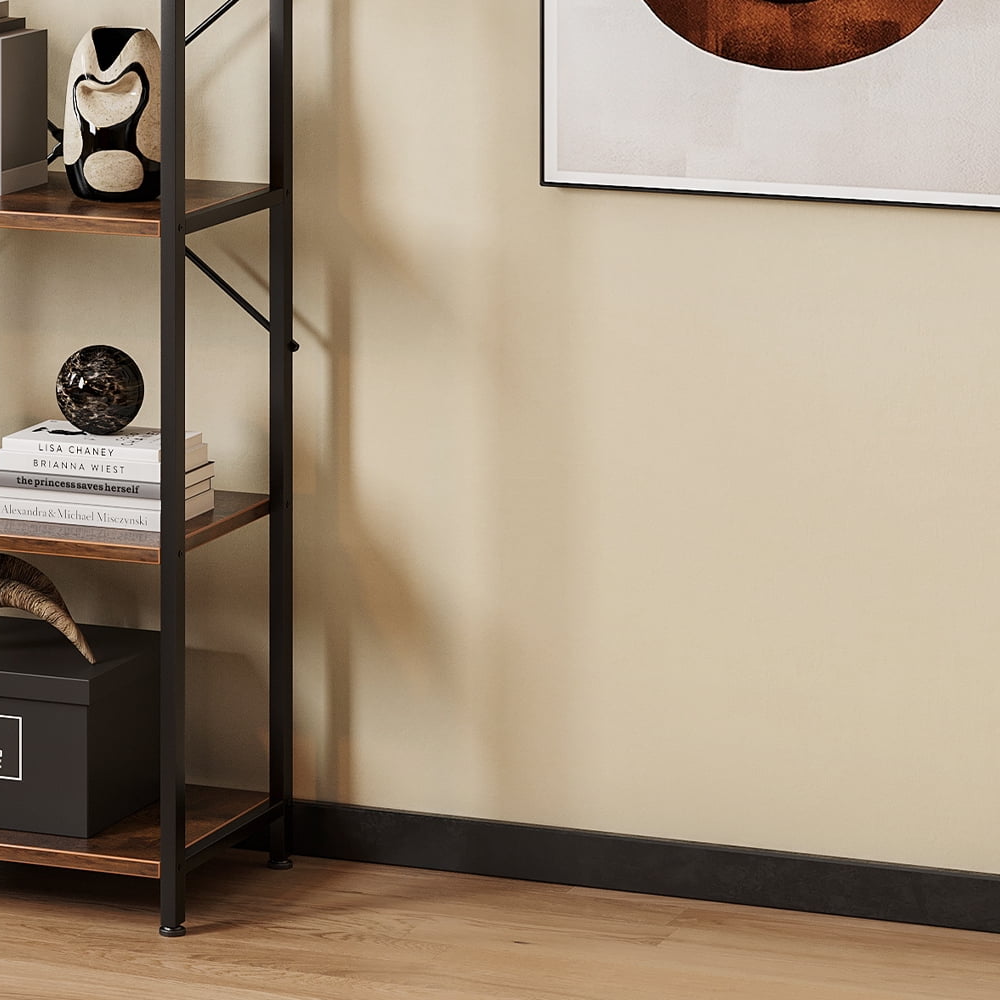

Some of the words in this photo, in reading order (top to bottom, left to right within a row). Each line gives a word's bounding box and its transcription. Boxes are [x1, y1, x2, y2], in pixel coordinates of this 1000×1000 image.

[38, 443, 63, 453] LISA
[68, 446, 114, 457] CHANEY
[33, 459, 85, 471] BRIANNA
[91, 464, 125, 474] WIEST
[16, 476, 33, 485] the
[34, 478, 76, 490] princess
[76, 483, 104, 491] saves
[104, 483, 140, 494] herself
[1, 504, 48, 518] Alexandra
[57, 508, 94, 521] Michael
